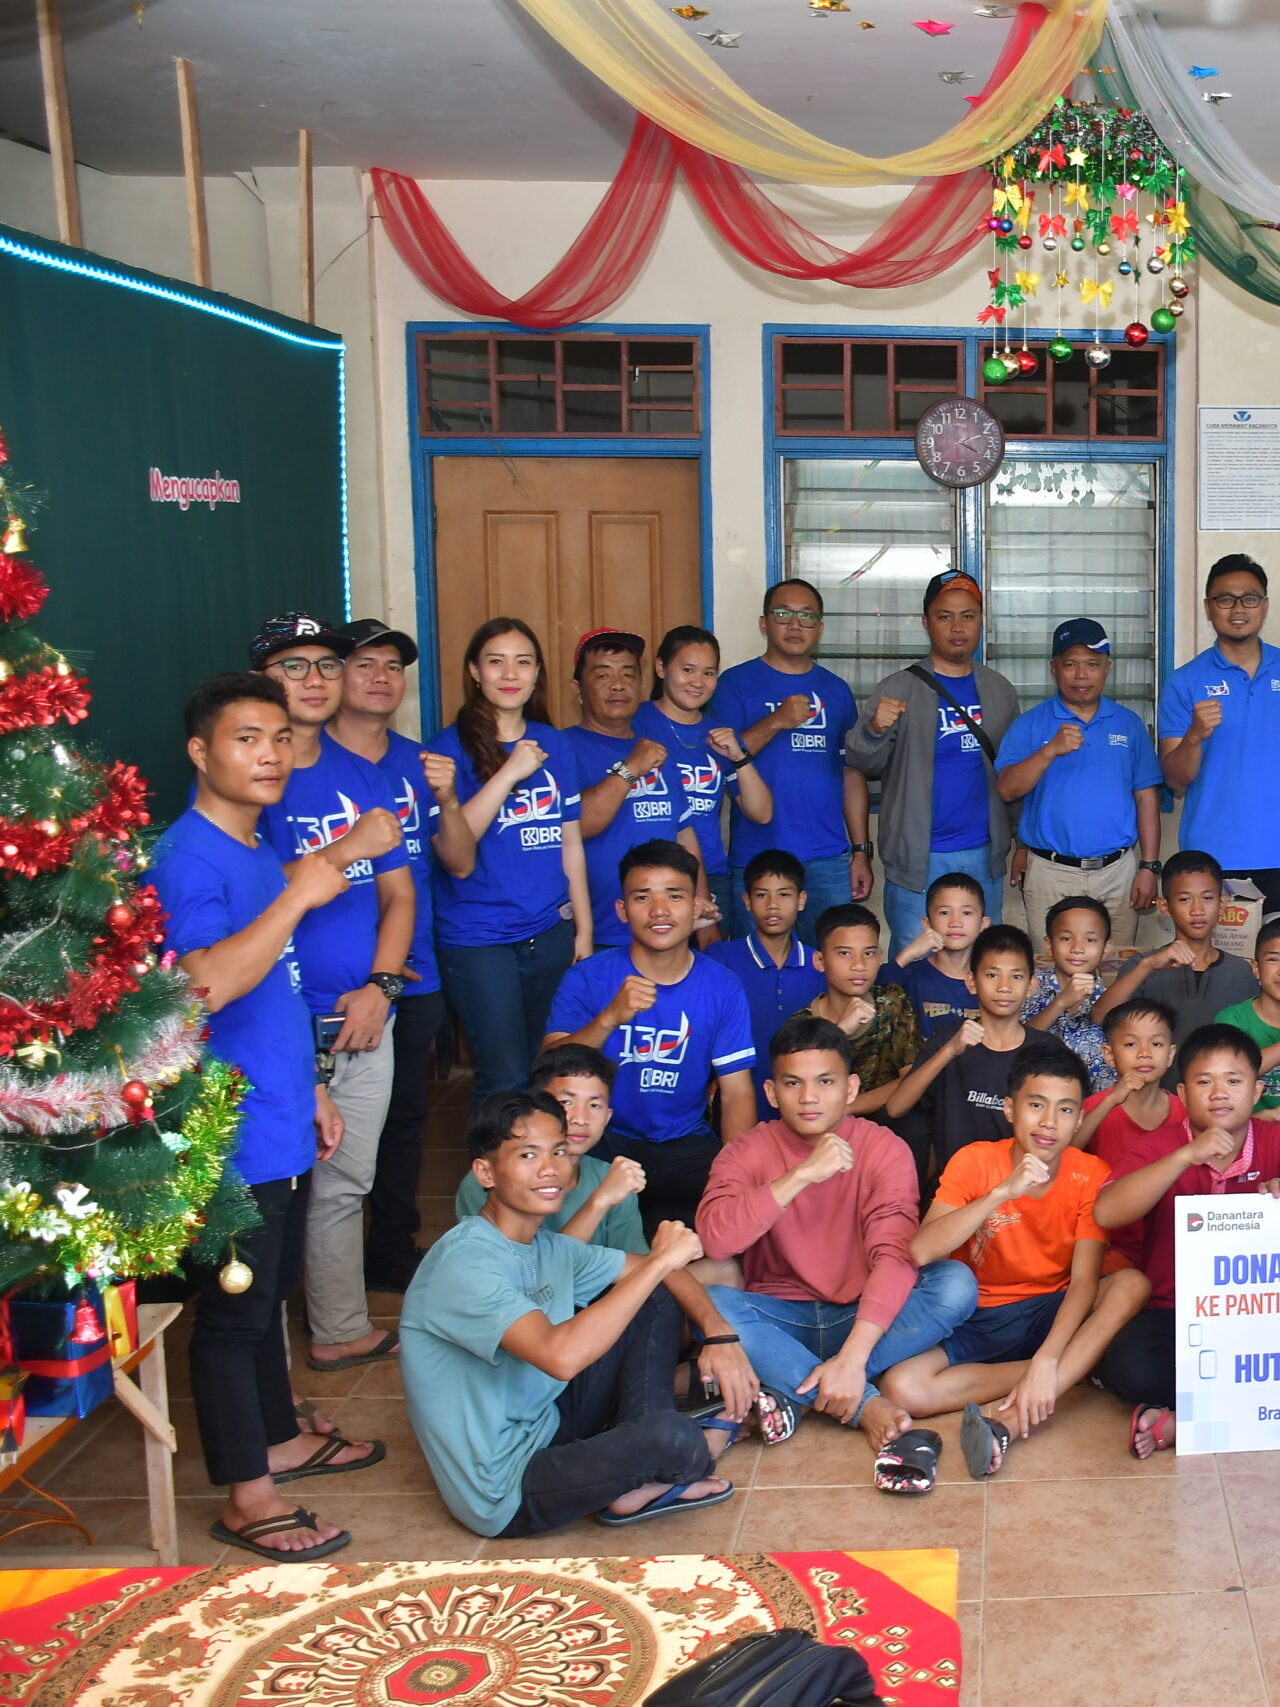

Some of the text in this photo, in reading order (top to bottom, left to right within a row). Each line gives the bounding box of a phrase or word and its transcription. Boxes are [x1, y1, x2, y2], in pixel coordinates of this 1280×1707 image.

[941, 413, 951, 424] 11
[954, 408, 966, 419] 12
[973, 412, 978, 423] 1
[931, 424, 943, 435] 10
[983, 423, 991, 434] 2
[927, 437, 934, 448] 9
[987, 436, 995, 448] 3
[933, 452, 941, 462] 8
[983, 450, 991, 460] 4
[943, 462, 951, 473] 7
[957, 465, 965, 476] 6
[973, 461, 980, 473] 5
[149, 467, 240, 511] Mengucapkan
[805, 735, 826, 748] BRI
[650, 801, 672, 817] BRI
[540, 826, 562, 843] BR
[406, 839, 421, 854] RI
[1219, 911, 1245, 922] ABC
[618, 1011, 691, 1066] 130
[651, 1069, 679, 1088] BRI
[1207, 1210, 1264, 1221] Danantara
[1207, 1221, 1260, 1232] Indonesia
[1195, 1295, 1220, 1317] KE
[1225, 1292, 1280, 1315] PANTI
